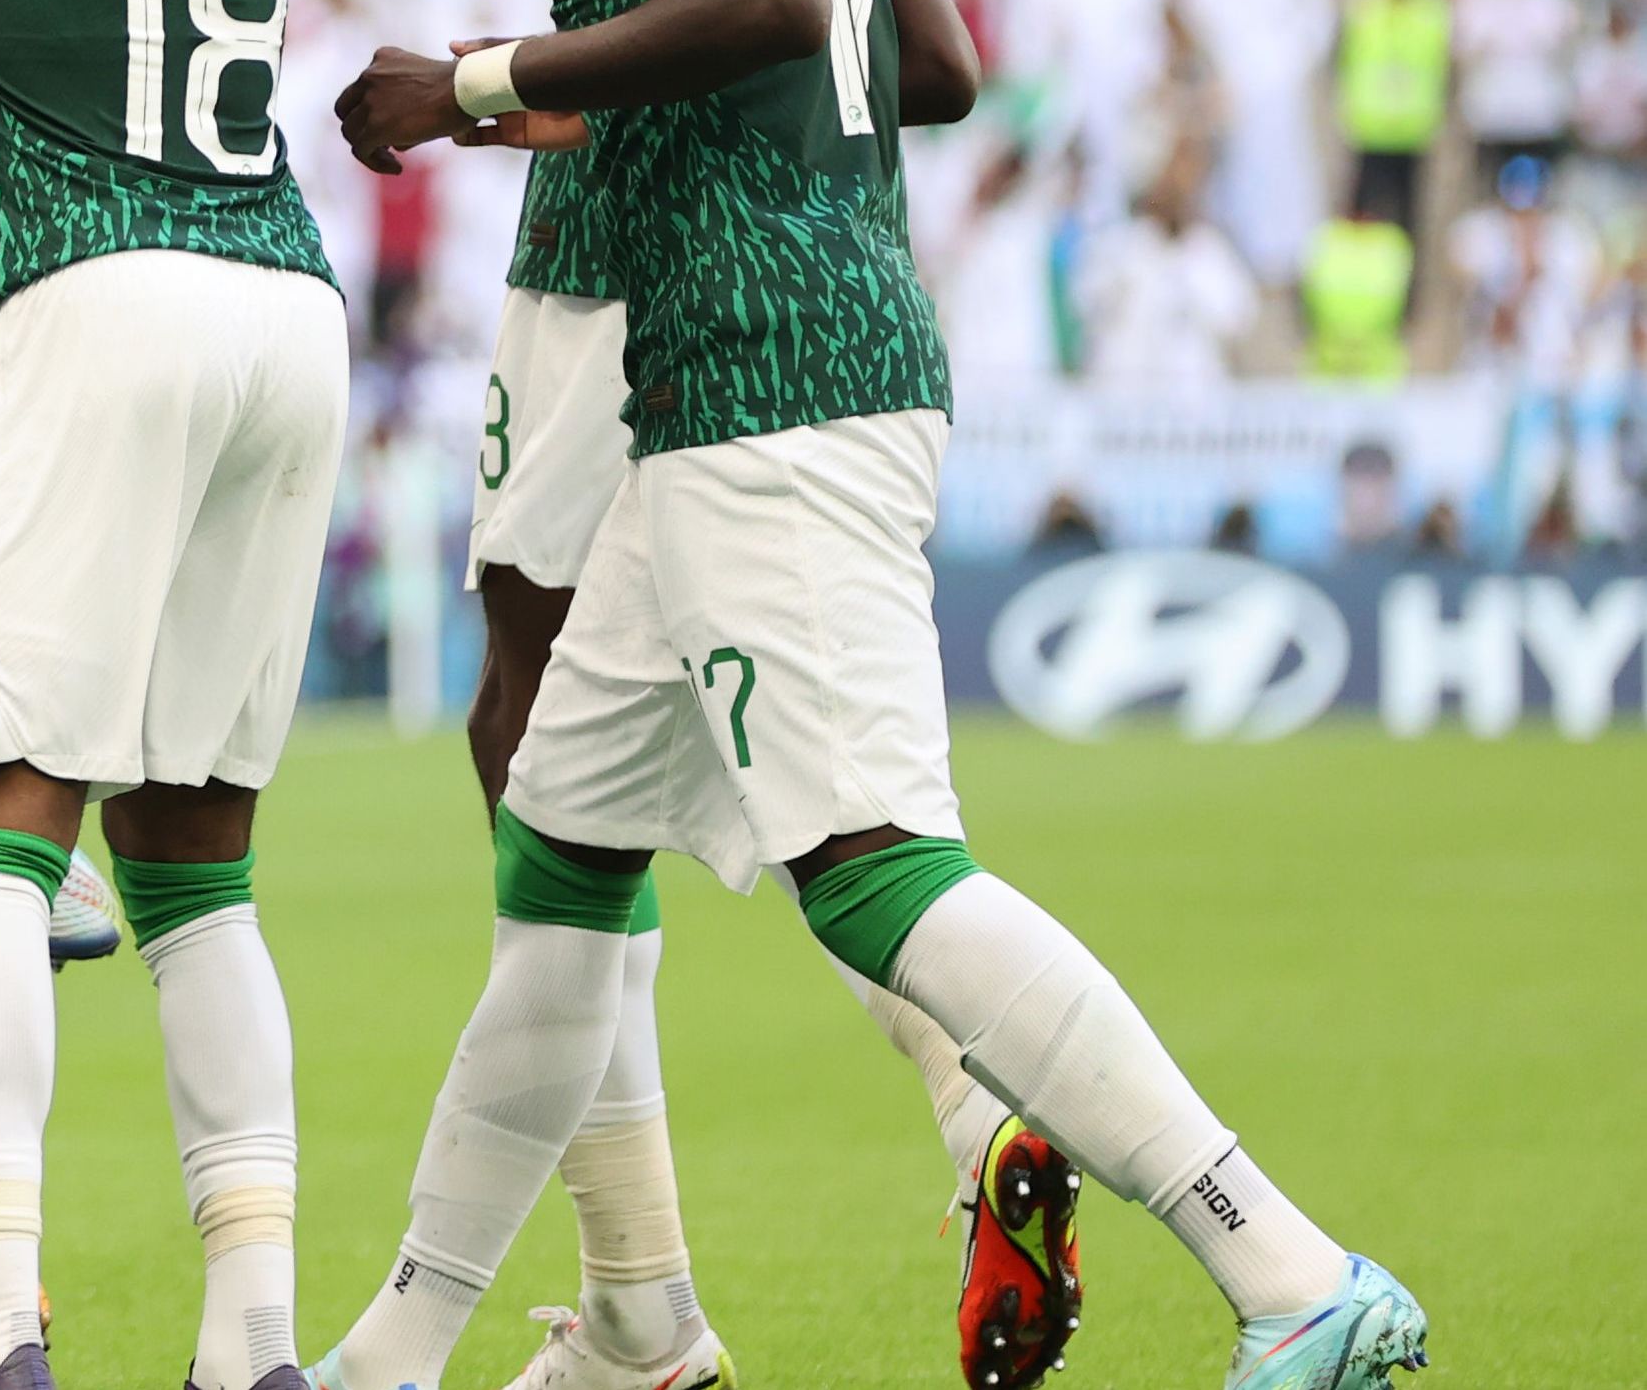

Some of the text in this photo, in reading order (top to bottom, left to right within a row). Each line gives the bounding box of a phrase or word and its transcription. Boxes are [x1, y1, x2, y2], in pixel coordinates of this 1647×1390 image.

[681, 646, 756, 773] 7
[1377, 572, 1647, 740] HY
[1192, 1172, 1247, 1232] SIGN
